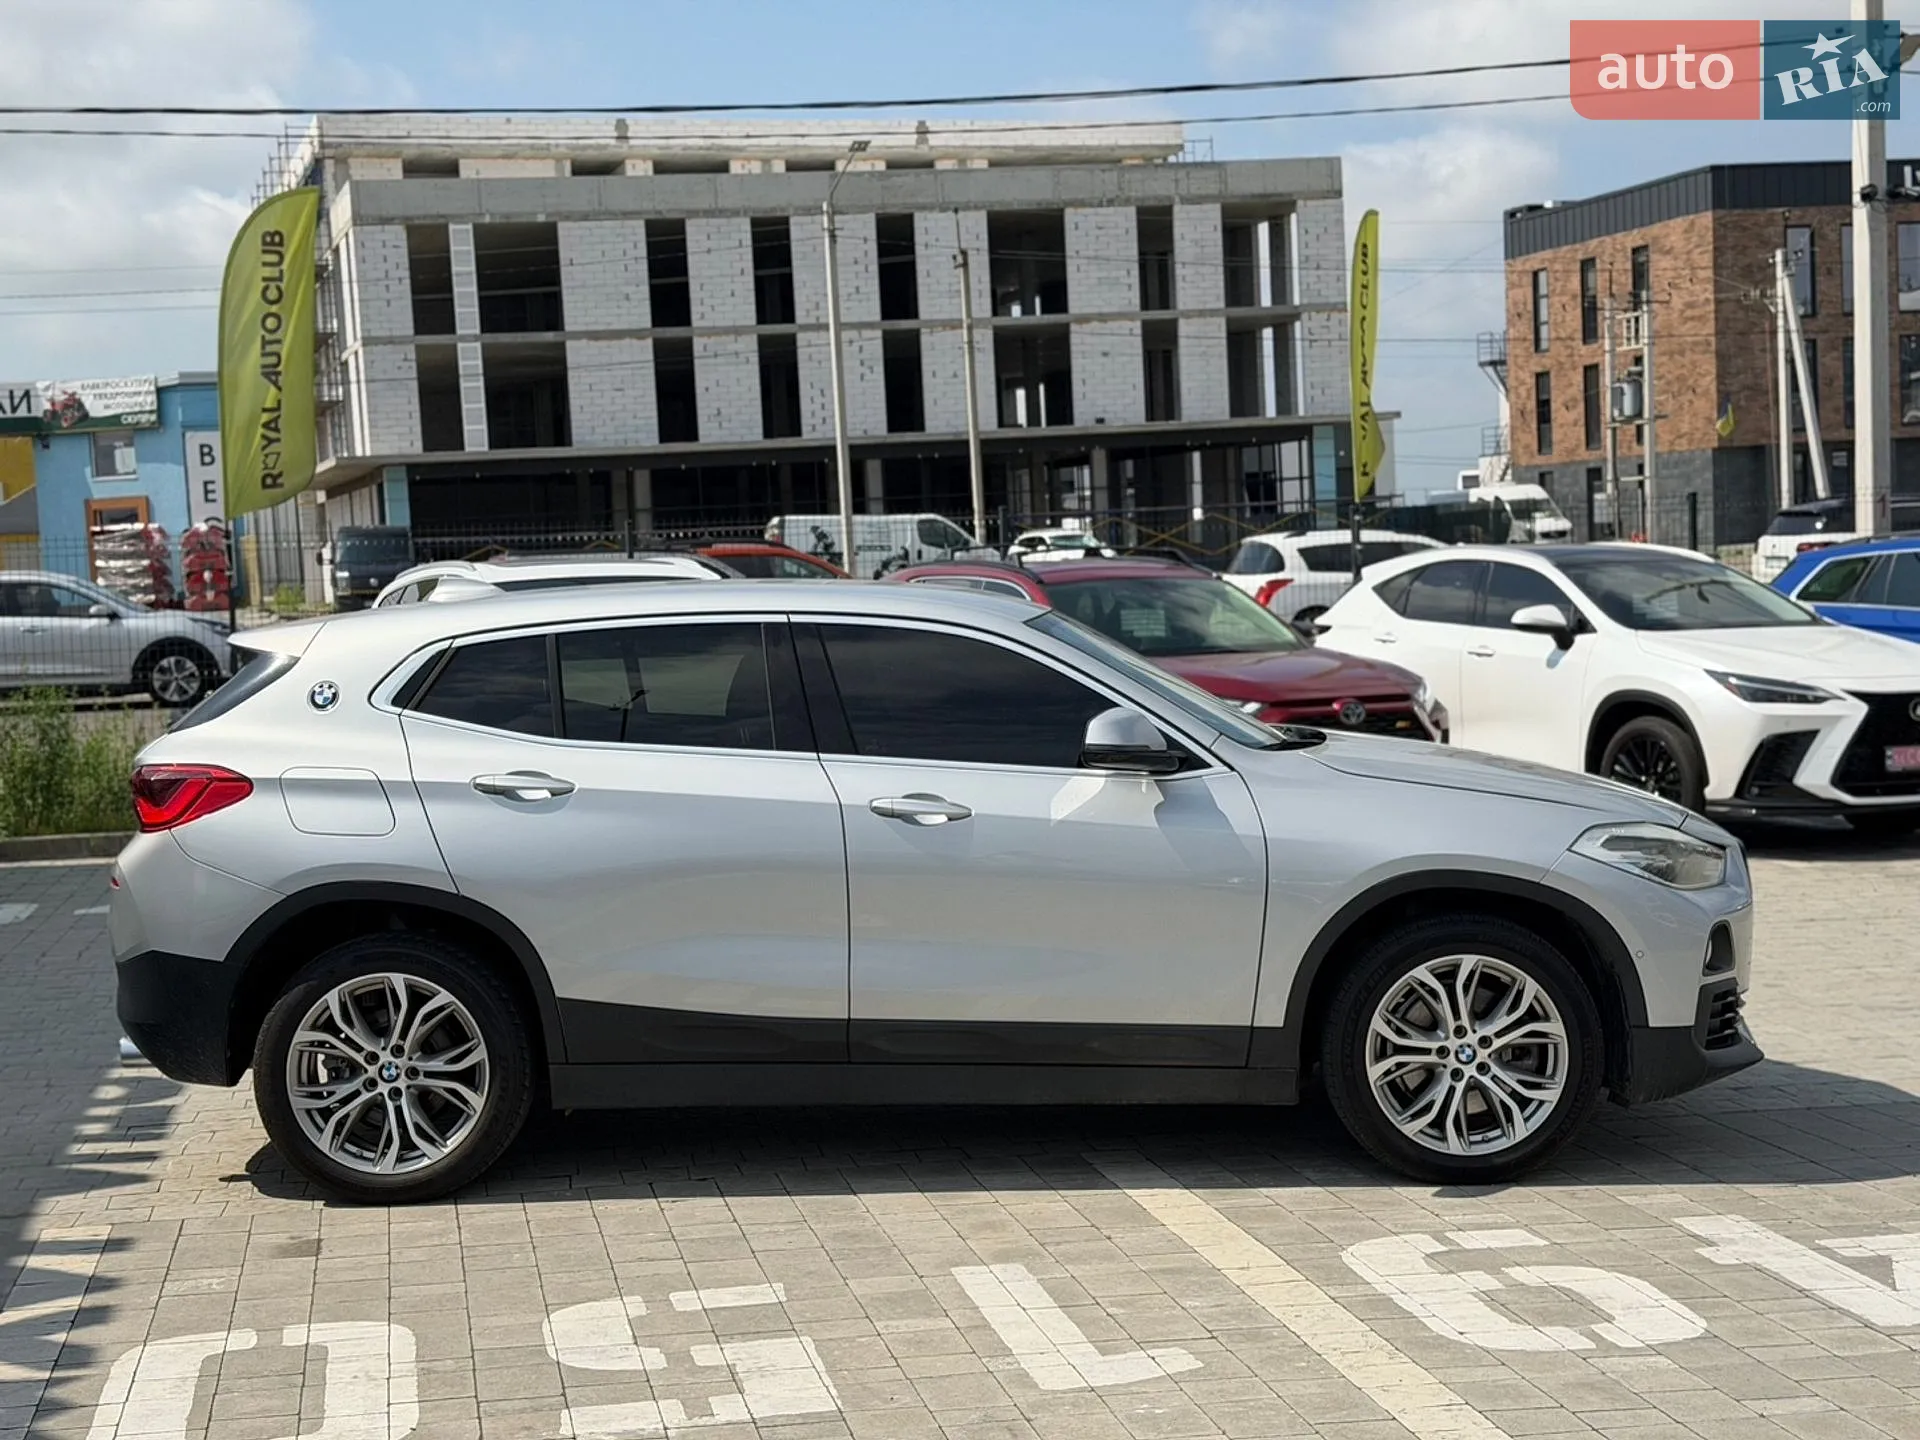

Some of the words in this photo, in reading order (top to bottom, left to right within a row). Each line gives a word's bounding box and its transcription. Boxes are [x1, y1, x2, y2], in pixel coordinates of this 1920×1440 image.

[261, 229, 285, 306] CLUB
[1358, 242, 1369, 310] CLUB
[260, 311, 284, 392] AUTO
